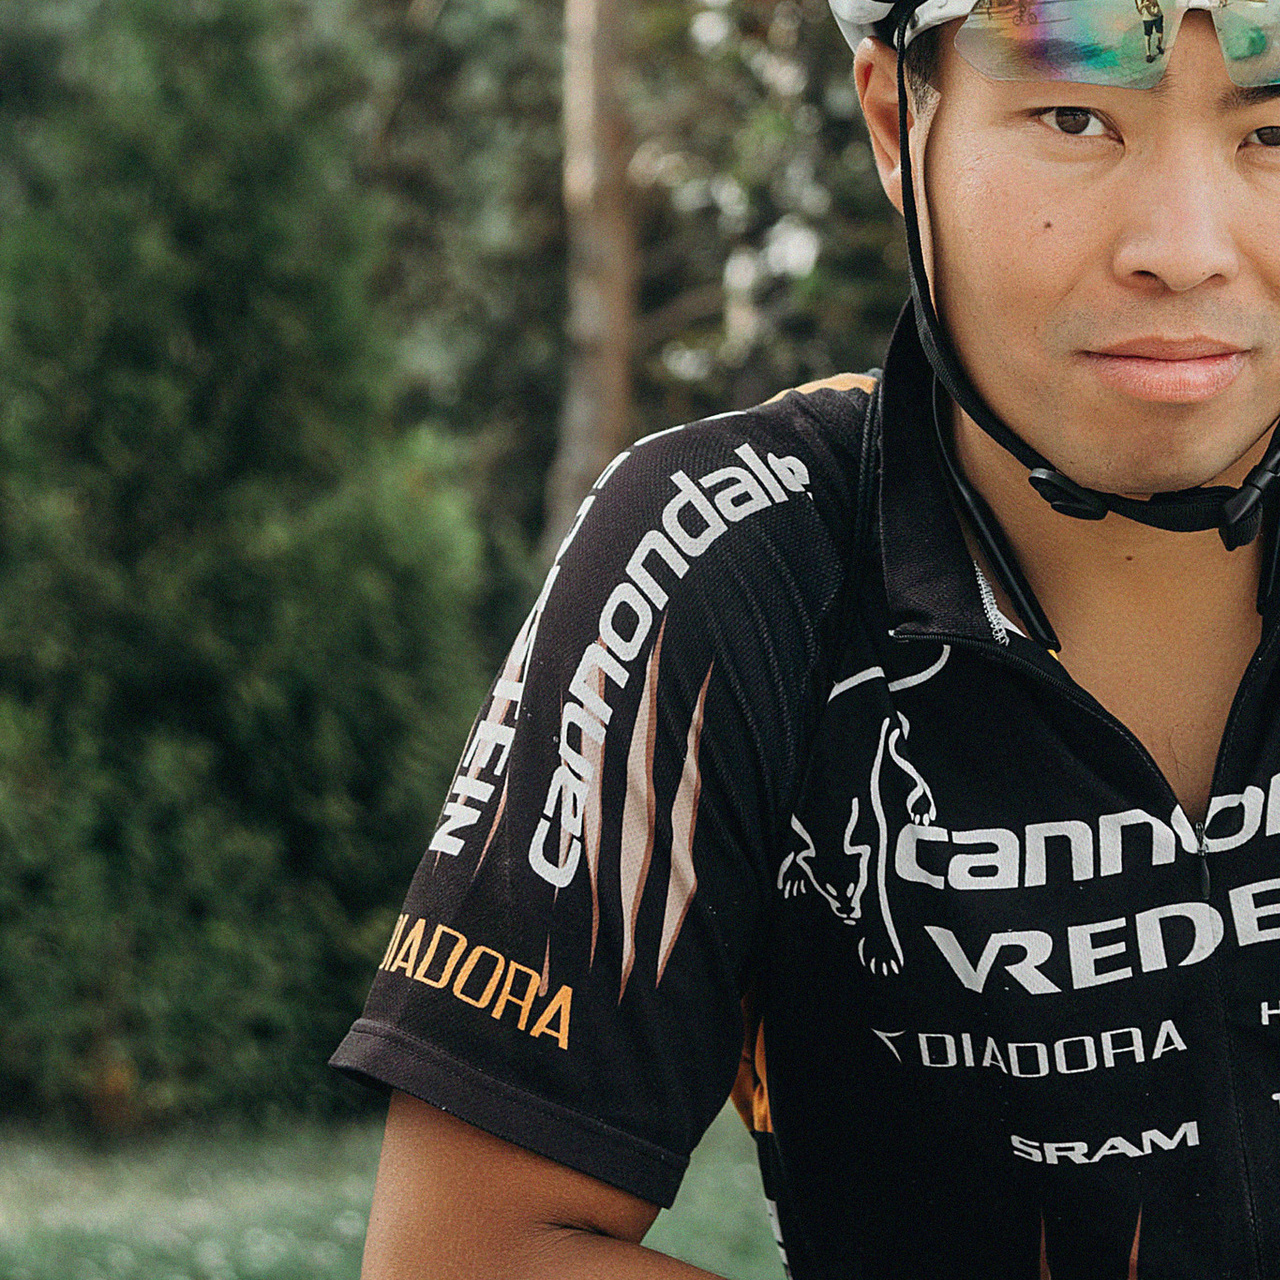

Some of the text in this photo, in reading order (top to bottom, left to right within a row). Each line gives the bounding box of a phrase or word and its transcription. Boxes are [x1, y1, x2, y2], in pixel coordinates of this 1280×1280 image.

[379, 913, 573, 1051] IADORA
[917, 1019, 1188, 1078] DIADORA
[1010, 1120, 1200, 1165] SRAM
